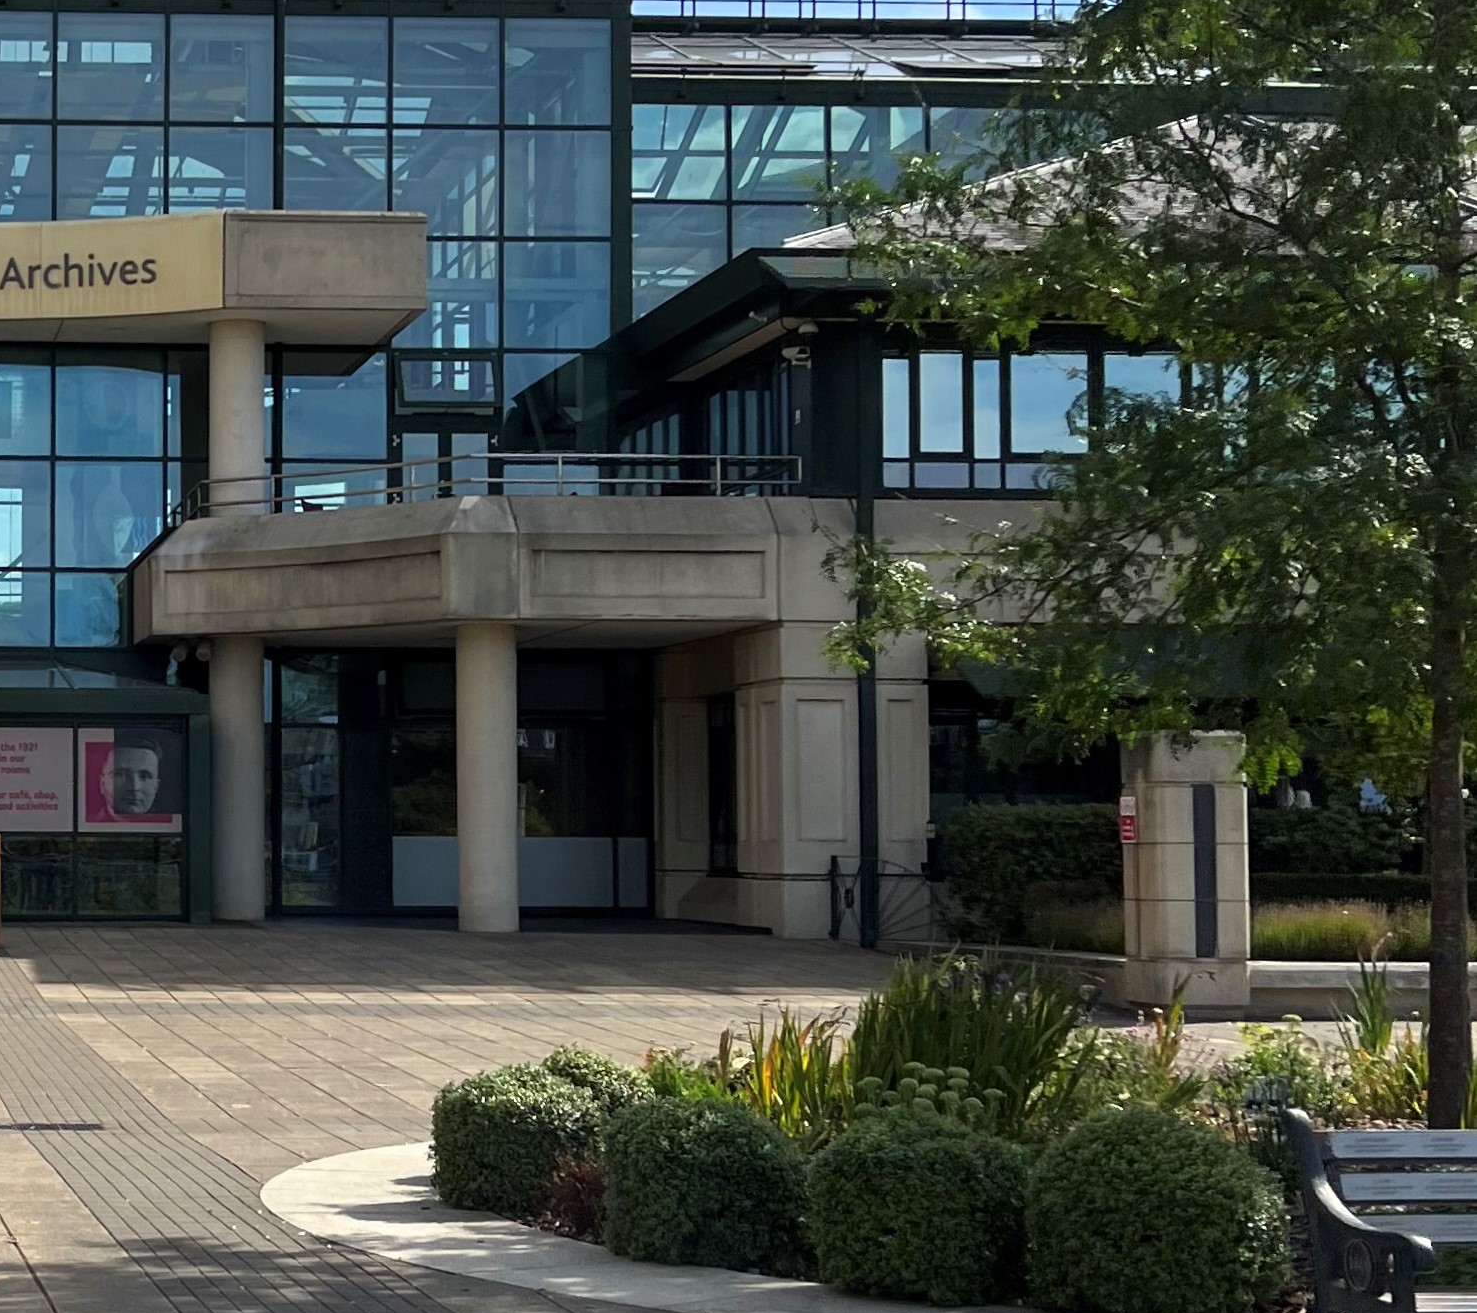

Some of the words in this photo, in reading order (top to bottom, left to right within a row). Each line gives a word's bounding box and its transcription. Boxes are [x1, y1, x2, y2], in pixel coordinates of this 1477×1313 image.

[0, 252, 158, 290] Archives
[0, 742, 16, 752] the
[18, 742, 38, 752] 1921
[0, 753, 8, 763] in
